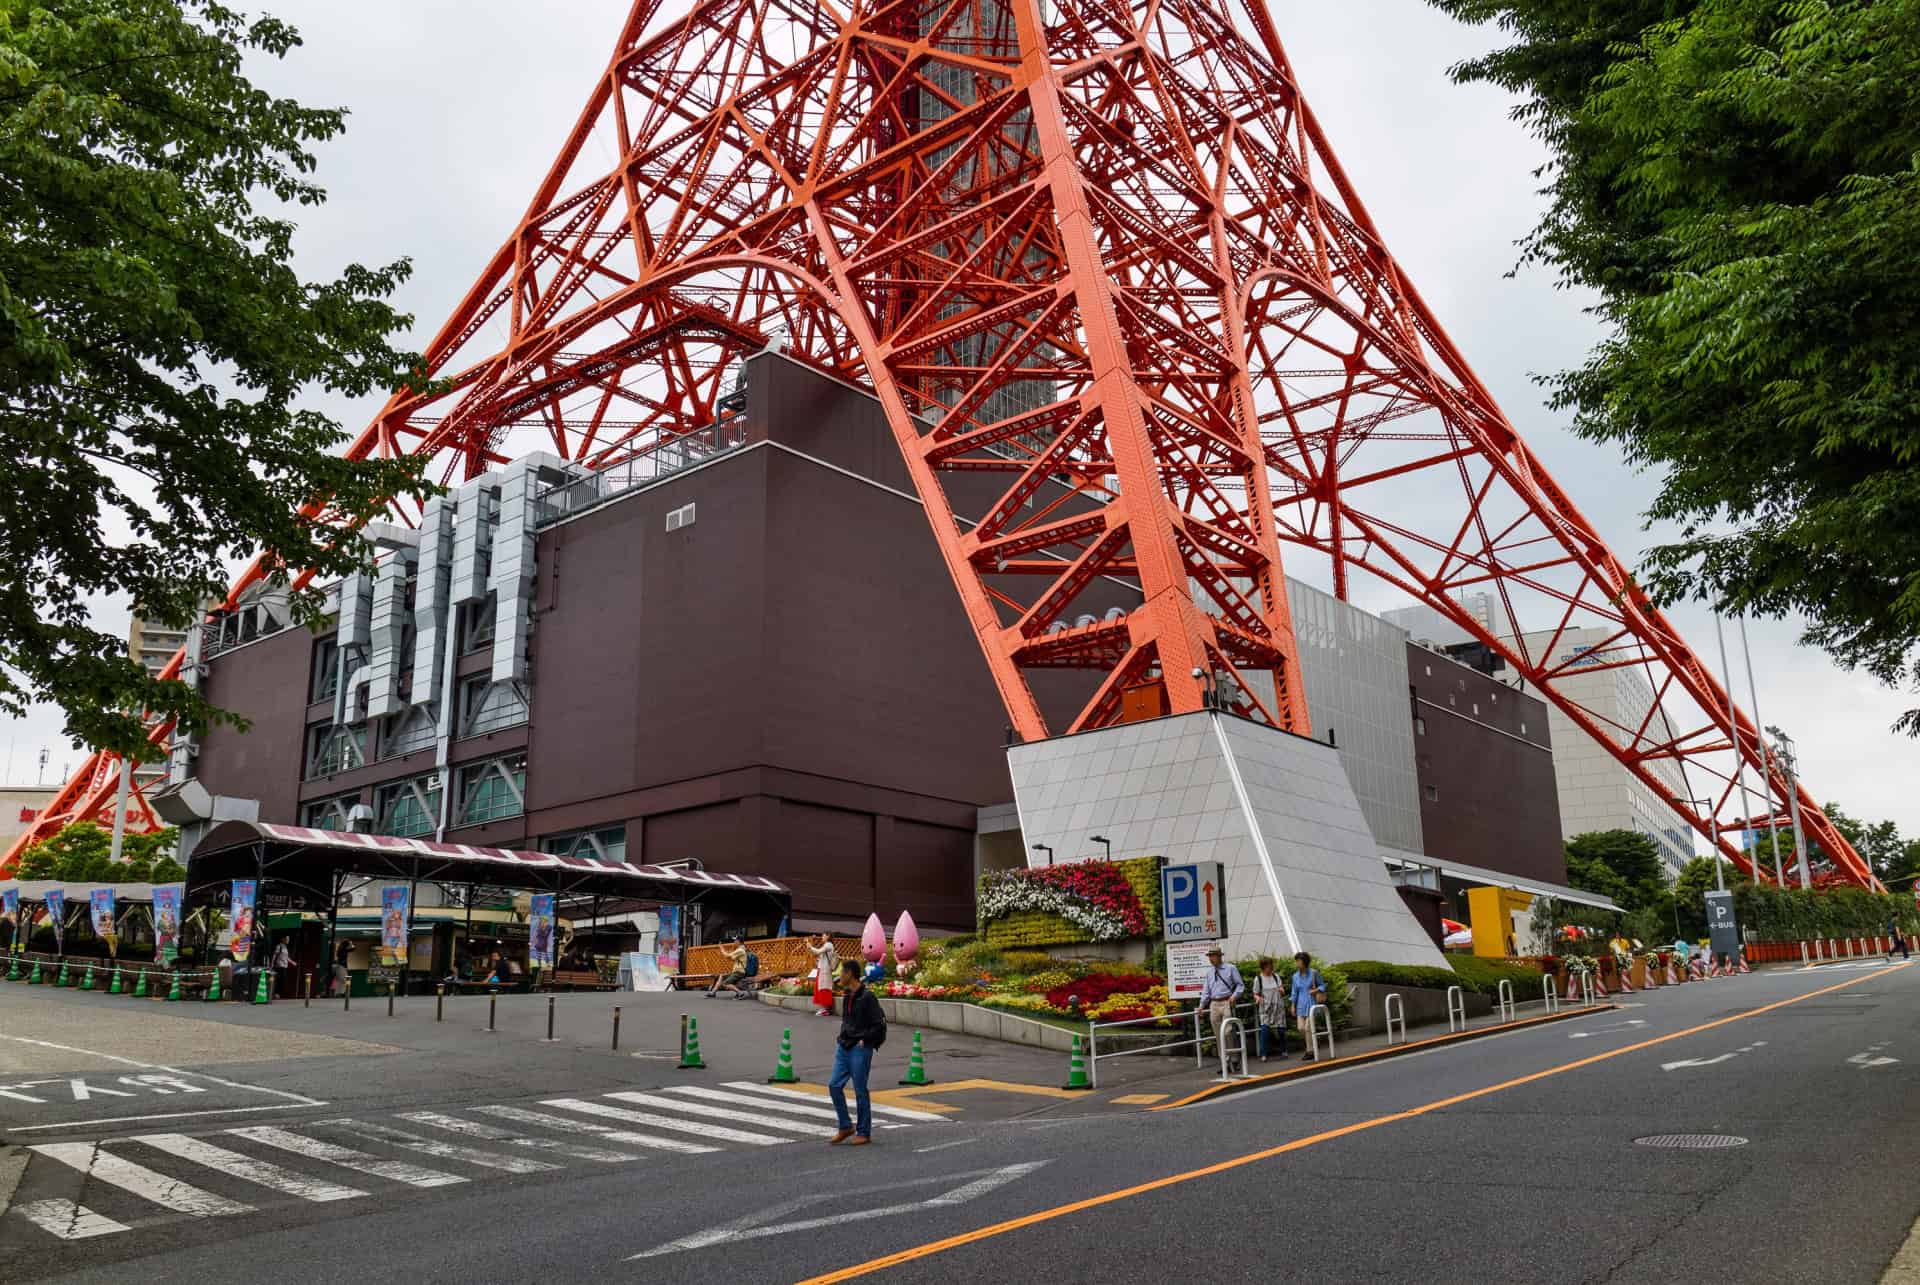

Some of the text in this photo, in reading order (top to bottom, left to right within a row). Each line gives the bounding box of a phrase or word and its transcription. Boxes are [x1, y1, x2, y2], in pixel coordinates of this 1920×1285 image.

[1167, 870, 1193, 915] P
[1716, 906, 1727, 919] P
[1168, 921, 1202, 935] 100m
[1718, 921, 1735, 929] BUS
